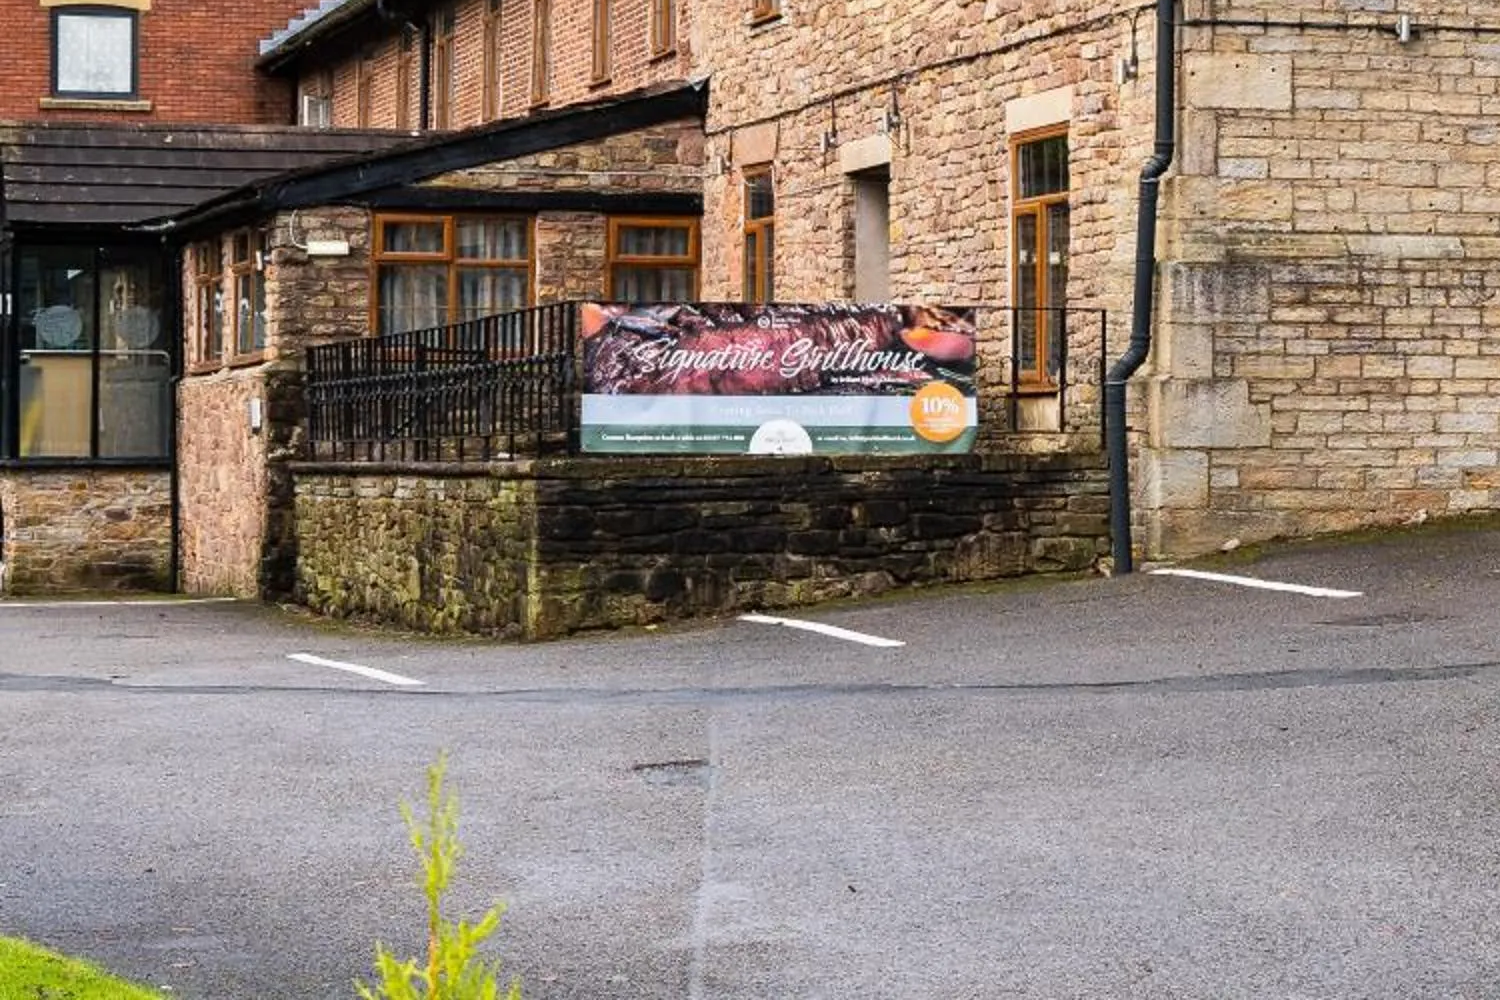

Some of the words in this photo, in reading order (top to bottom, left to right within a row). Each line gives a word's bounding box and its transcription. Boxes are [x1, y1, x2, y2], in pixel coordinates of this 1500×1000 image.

[633, 337, 775, 385] Signature
[779, 337, 926, 378] Grillhouse
[921, 397, 960, 415] 10%
